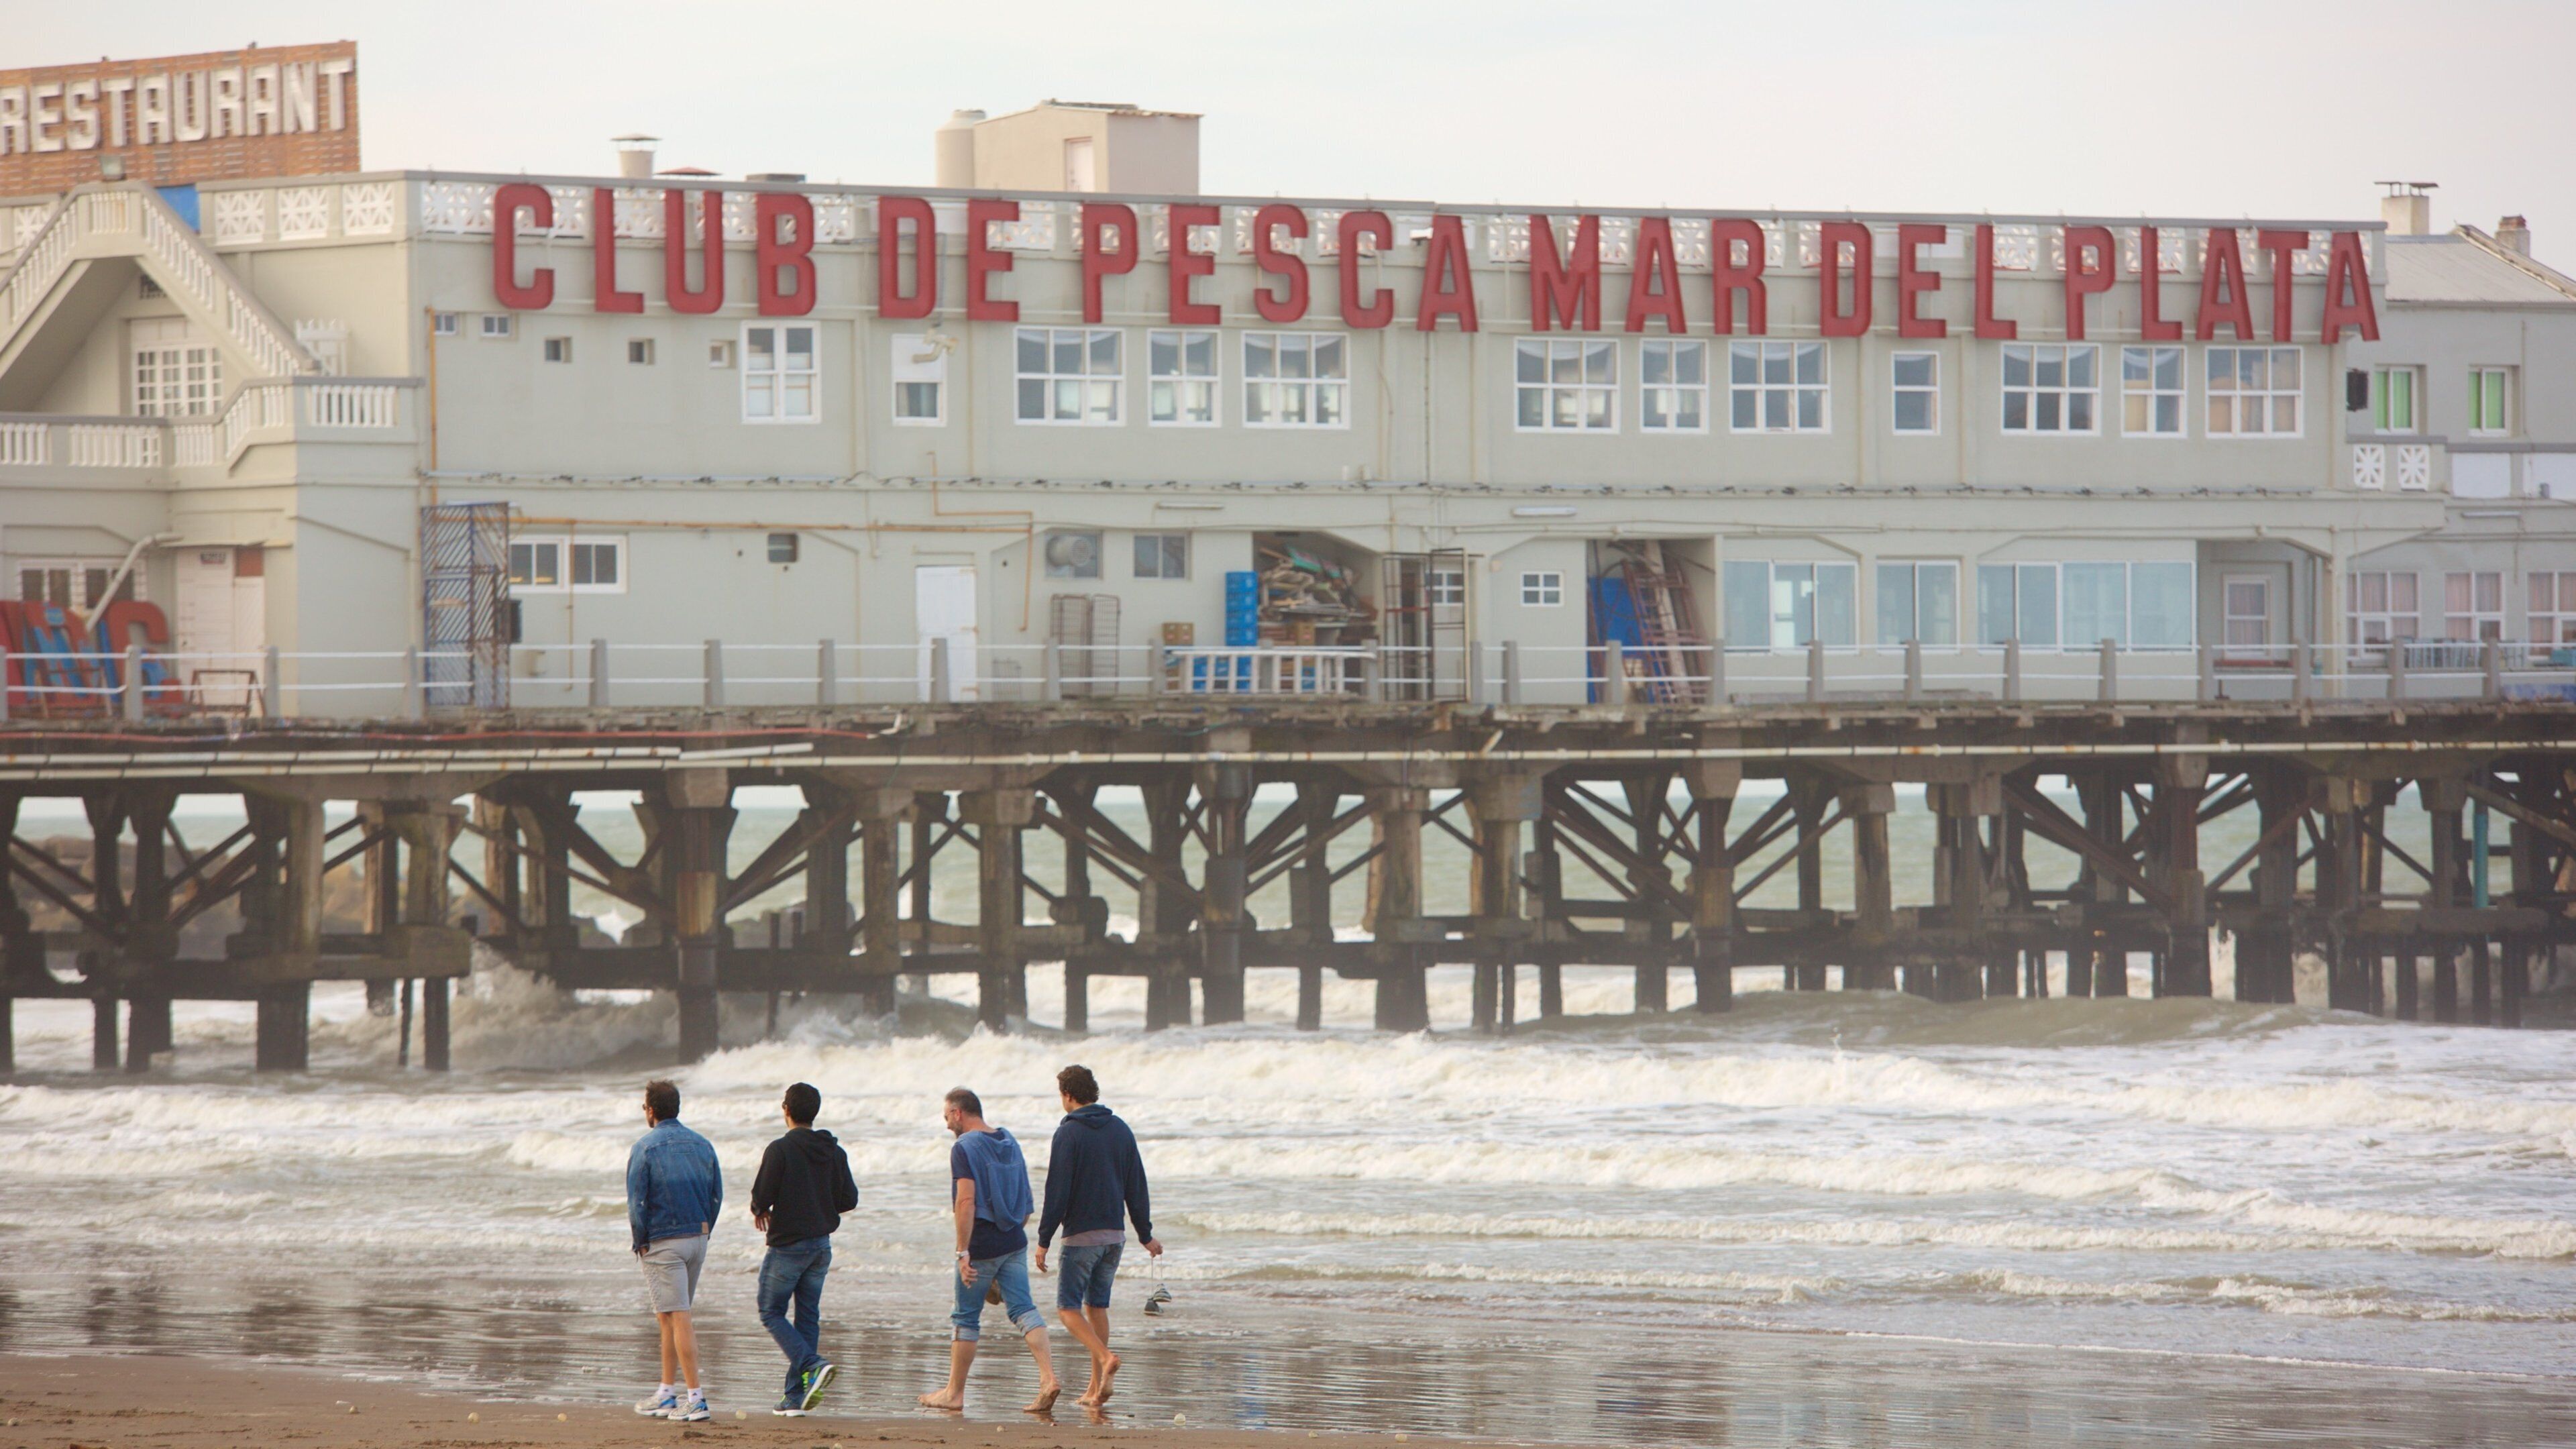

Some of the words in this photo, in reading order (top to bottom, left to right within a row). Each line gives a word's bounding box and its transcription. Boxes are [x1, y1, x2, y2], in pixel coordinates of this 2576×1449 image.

[0, 56, 354, 155] RESTAURANT
[493, 182, 817, 317] CLUB
[877, 195, 1020, 323] DE
[1081, 203, 1477, 332] PESCA
[1529, 214, 1768, 335] MAR
[1817, 221, 2017, 339] DEL
[2064, 226, 2379, 345] PLATA
